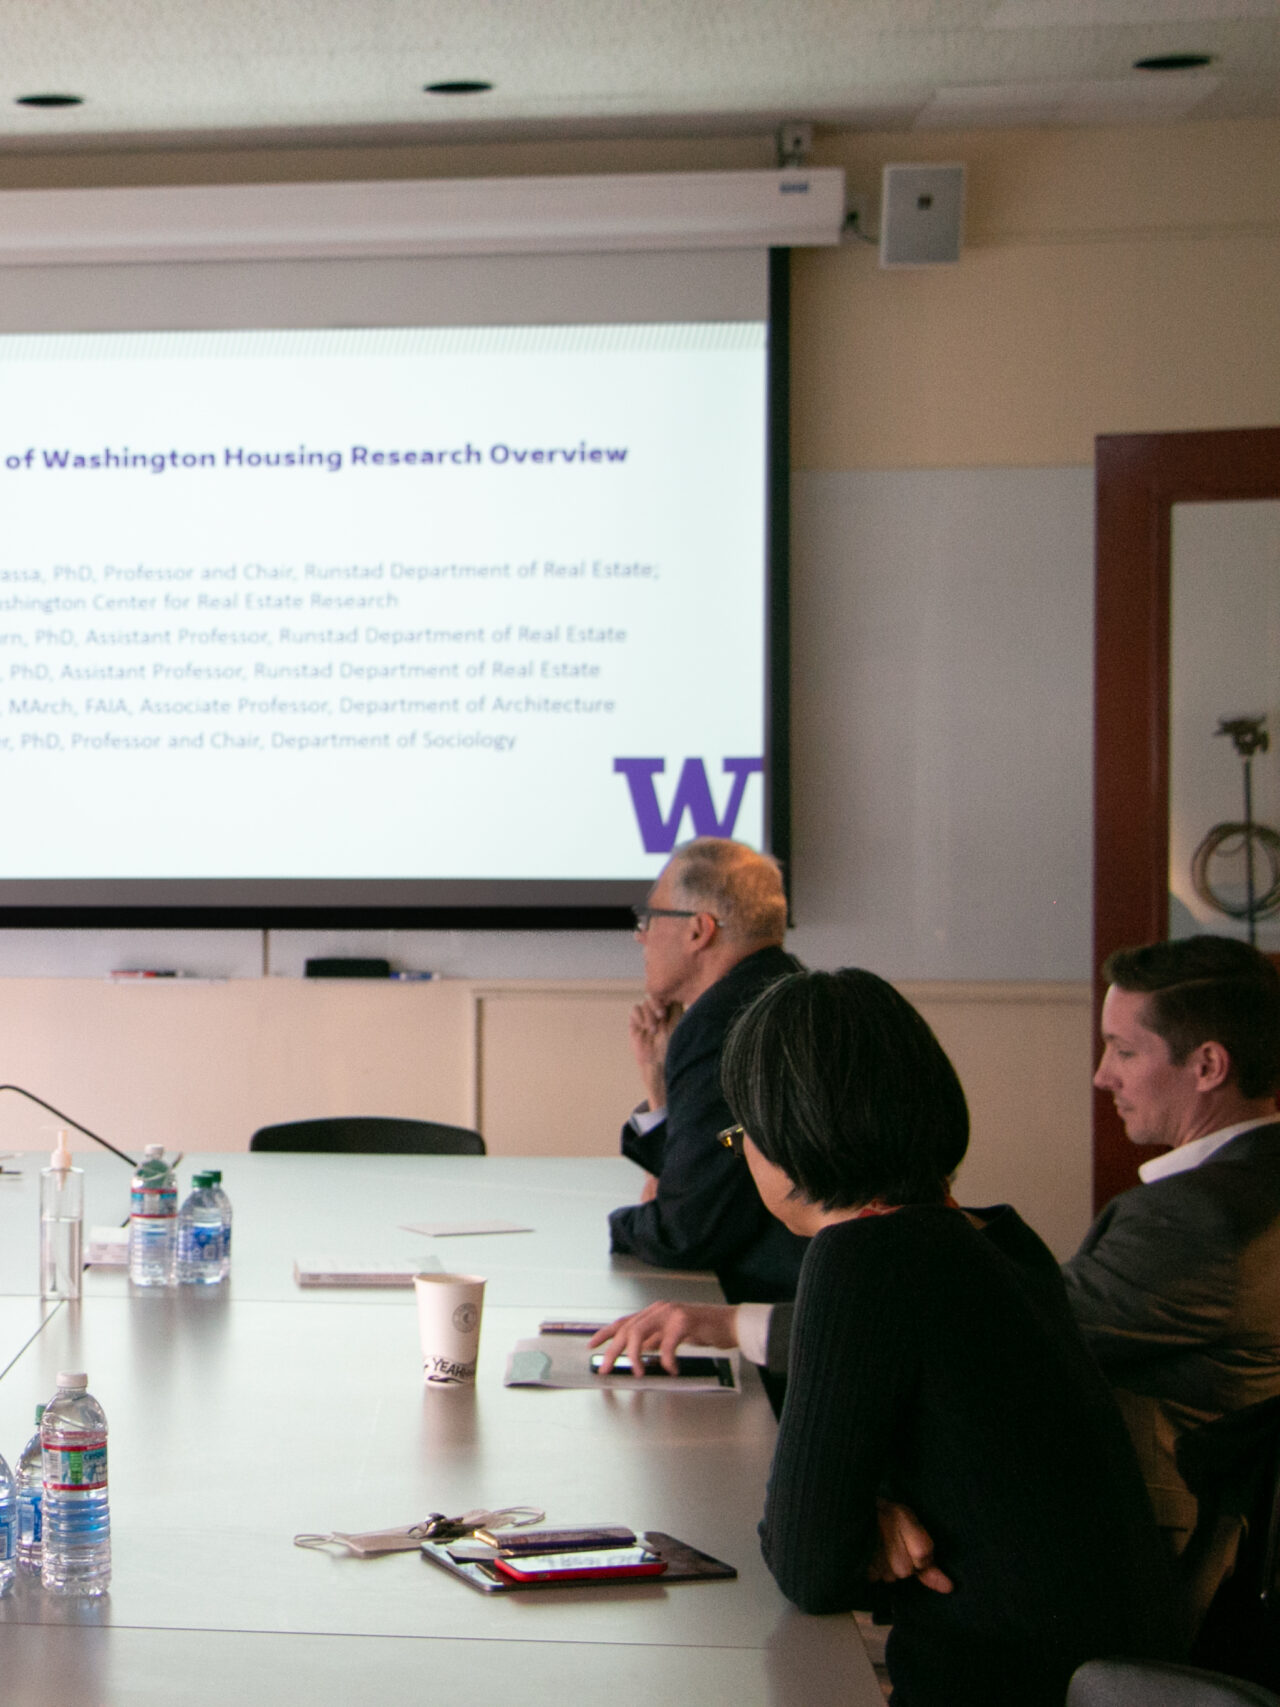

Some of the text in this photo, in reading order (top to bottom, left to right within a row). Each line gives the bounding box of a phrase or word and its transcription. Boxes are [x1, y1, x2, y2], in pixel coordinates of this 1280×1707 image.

[5, 447, 35, 470] of
[42, 447, 216, 474] Washington
[224, 444, 343, 472] Housing
[351, 442, 482, 465] Research
[489, 441, 628, 464] Overview
[104, 562, 194, 582] Professor
[200, 563, 237, 581] and
[304, 562, 384, 580] Runstad
[390, 561, 511, 582] Department
[516, 559, 538, 579] of
[543, 560, 587, 579] Real
[91, 593, 157, 612] Center
[163, 591, 192, 611] for
[197, 592, 240, 611] Real
[244, 592, 305, 611] Estate
[310, 590, 400, 610] Research
[85, 628, 171, 646] Assistant
[279, 625, 359, 645] Runstad
[365, 626, 485, 647] Department
[491, 624, 513, 644] of
[518, 624, 561, 644] Real
[566, 624, 628, 644] Estate
[60, 663, 146, 680] Assistant
[254, 661, 334, 680] Runstad
[339, 661, 460, 682] Department
[465, 659, 487, 679] of
[492, 659, 535, 679] Real
[540, 660, 601, 679] Estate
[139, 697, 232, 715] Associate
[339, 696, 460, 717] Department
[465, 694, 487, 714] of
[492, 695, 616, 714] Architecture
[71, 731, 160, 750] Professor
[168, 732, 204, 749] and
[271, 731, 390, 751] Department
[396, 729, 417, 749] of
[423, 731, 516, 752] Sociology
[614, 757, 763, 853] W
